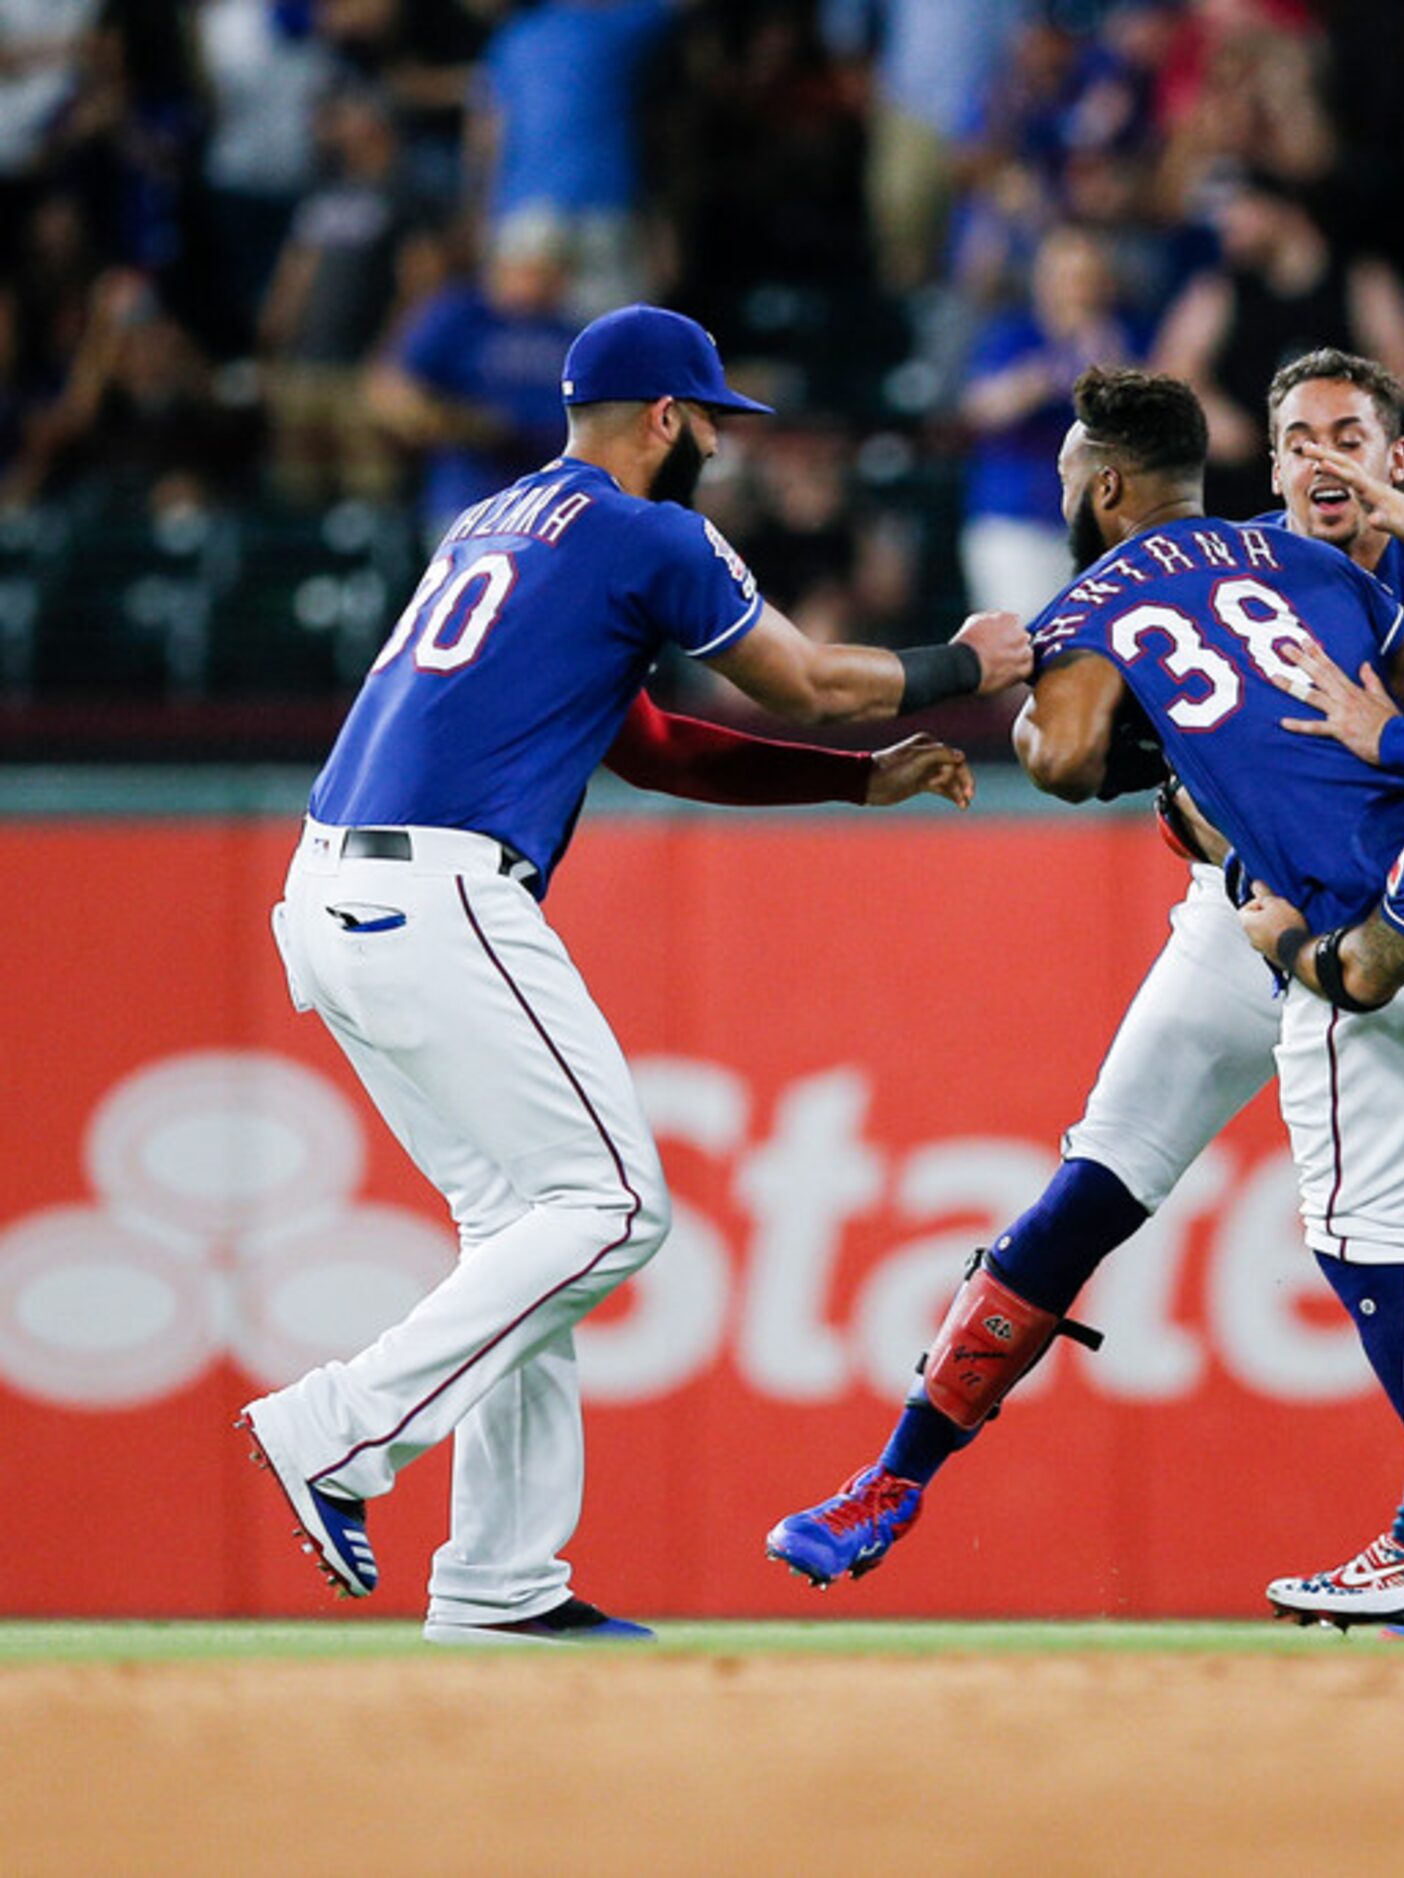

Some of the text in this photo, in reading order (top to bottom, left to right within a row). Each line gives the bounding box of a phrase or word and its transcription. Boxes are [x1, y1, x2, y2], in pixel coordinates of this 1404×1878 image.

[444, 483, 597, 548] AZARA
[1032, 528, 1284, 655] ANTANA
[1106, 573, 1323, 734] 38
